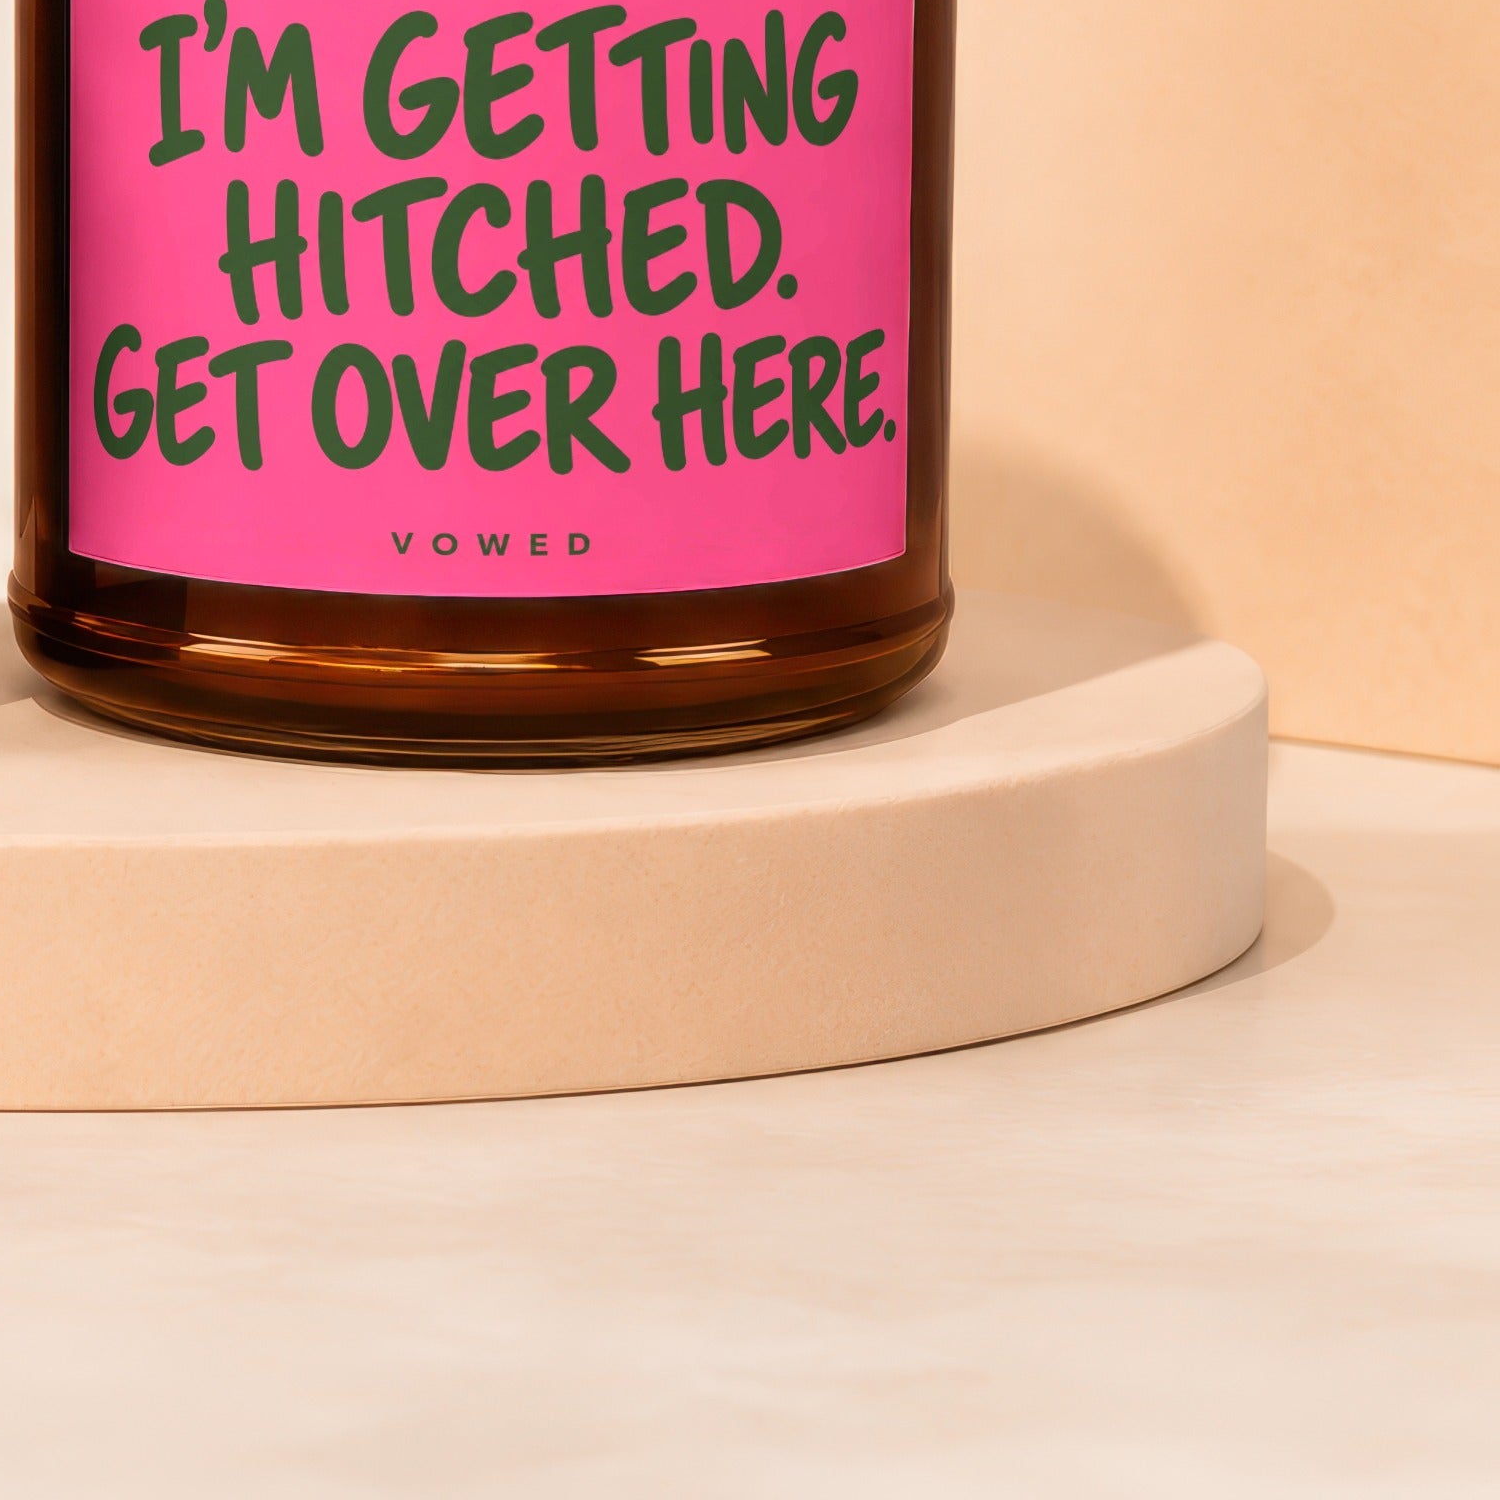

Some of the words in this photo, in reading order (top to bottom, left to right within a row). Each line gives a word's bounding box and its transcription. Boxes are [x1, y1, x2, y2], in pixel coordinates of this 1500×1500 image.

[363, 4, 859, 161] GETTING
[218, 174, 798, 326] HITCHED.
[93, 322, 294, 471] GET
[311, 339, 631, 475] OVER
[651, 328, 897, 472] HERE.
[392, 532, 590, 556] VOWED
